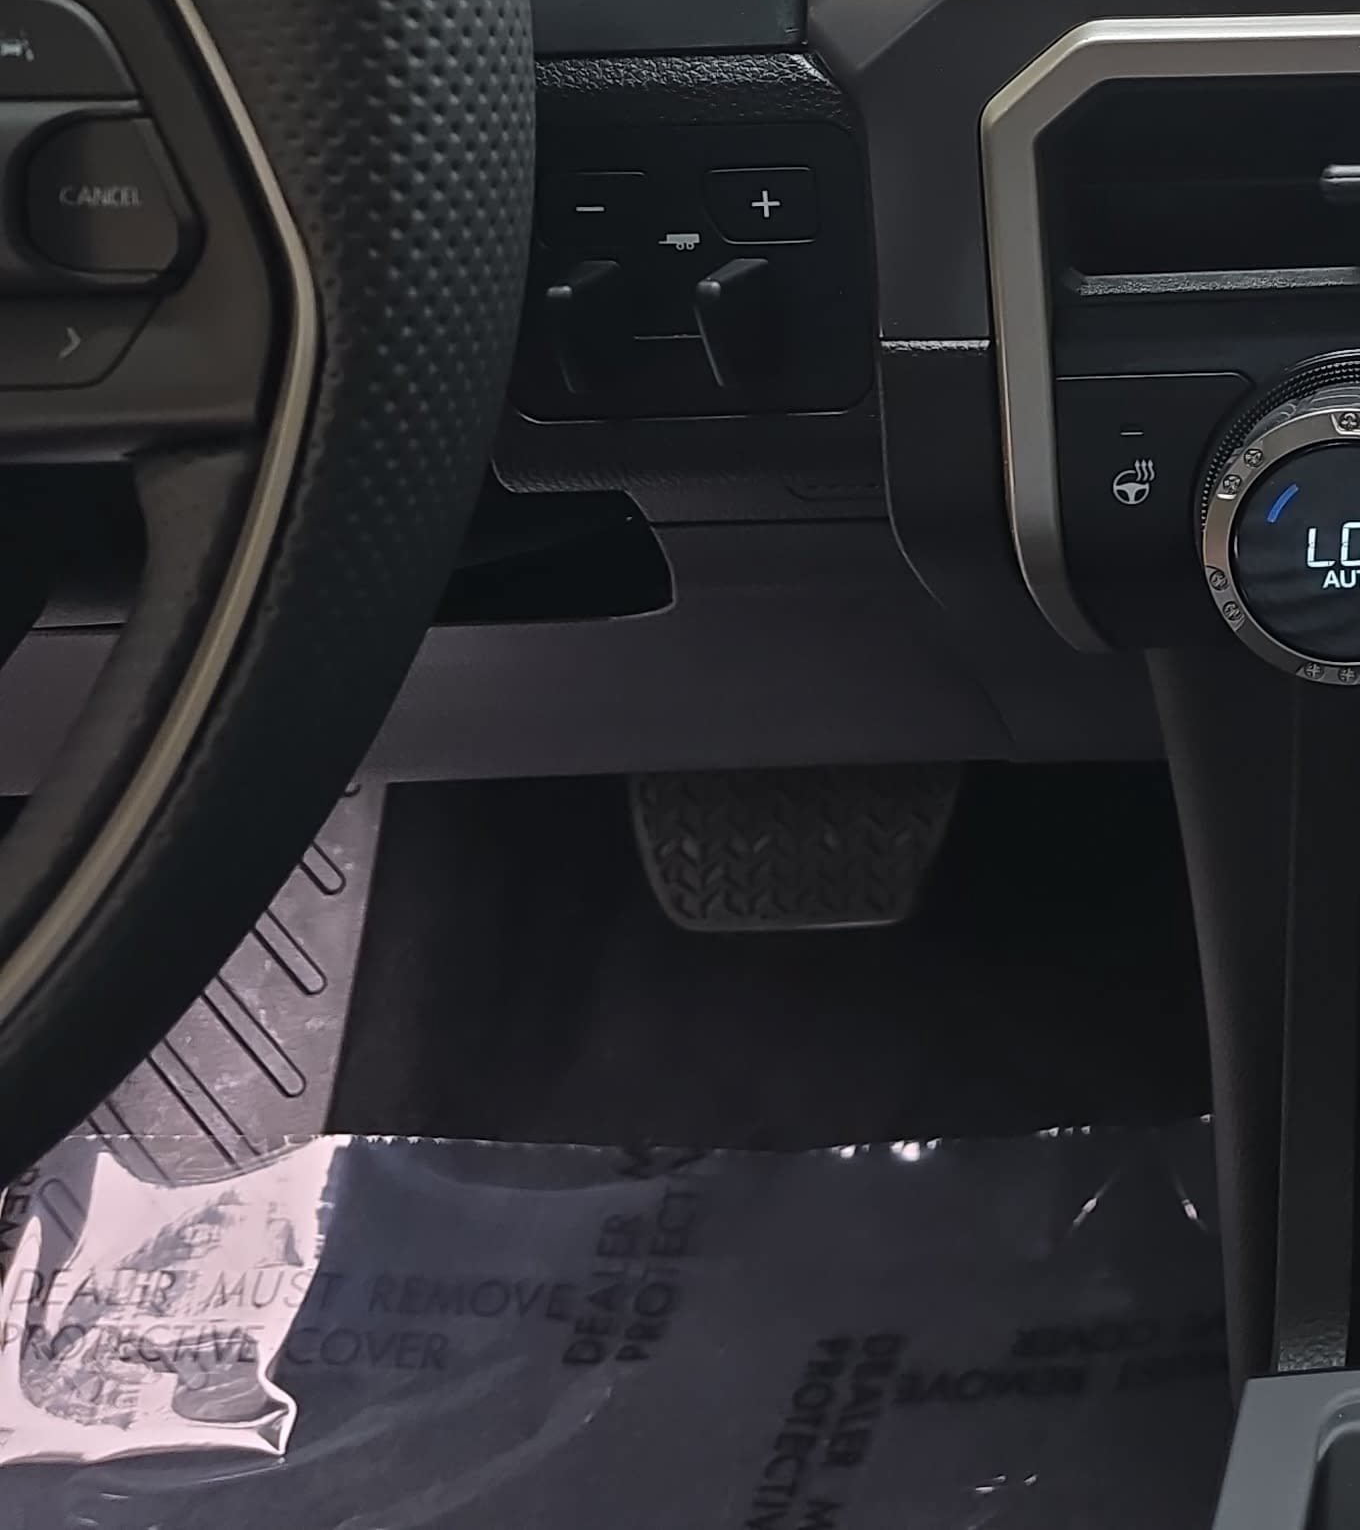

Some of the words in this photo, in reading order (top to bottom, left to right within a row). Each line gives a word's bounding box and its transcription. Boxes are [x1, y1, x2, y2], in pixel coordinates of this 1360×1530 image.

[58, 184, 143, 208] CANCEL
[366, 1272, 582, 1322] REMOVE
[285, 1325, 450, 1373] COVER
